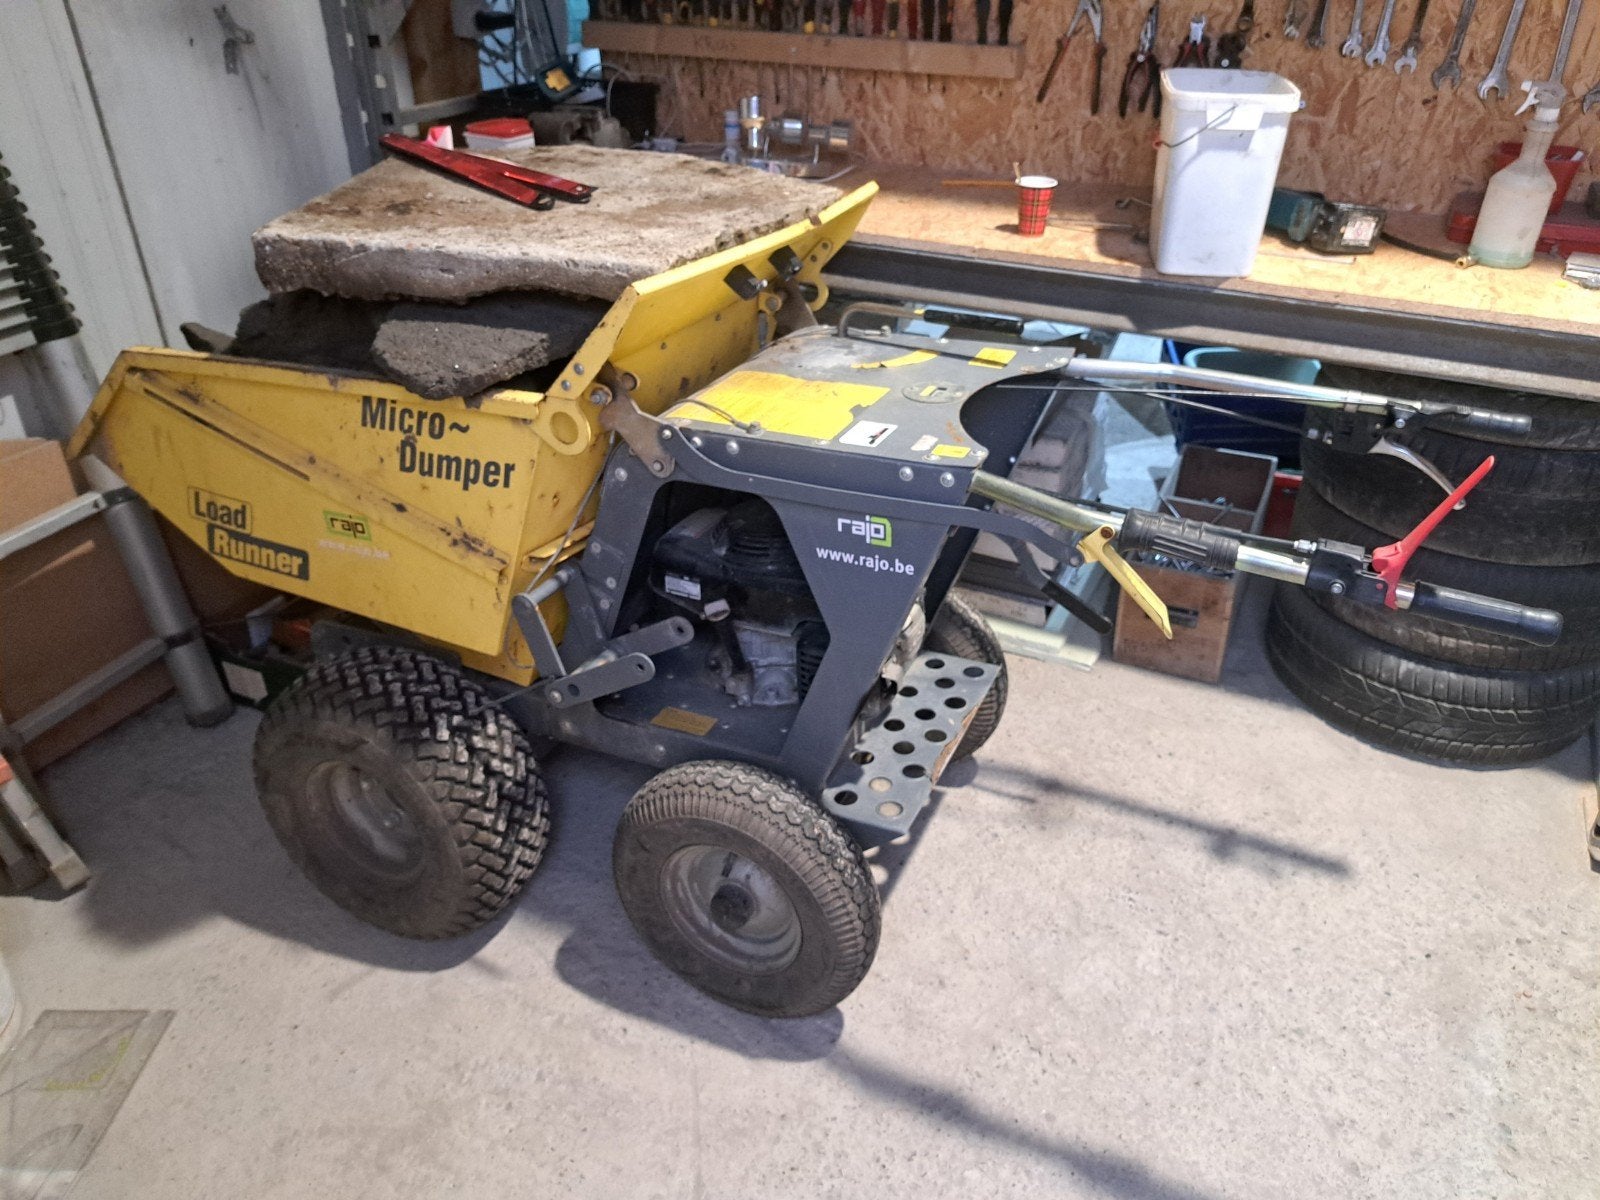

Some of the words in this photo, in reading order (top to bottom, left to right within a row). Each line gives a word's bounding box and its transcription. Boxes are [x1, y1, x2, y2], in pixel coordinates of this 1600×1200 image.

[399, 439, 515, 491] Dumper
[194, 490, 247, 529] Load
[837, 514, 885, 544] rajo
[211, 527, 305, 577] Runner
[816, 547, 915, 576] www.rajo.be
